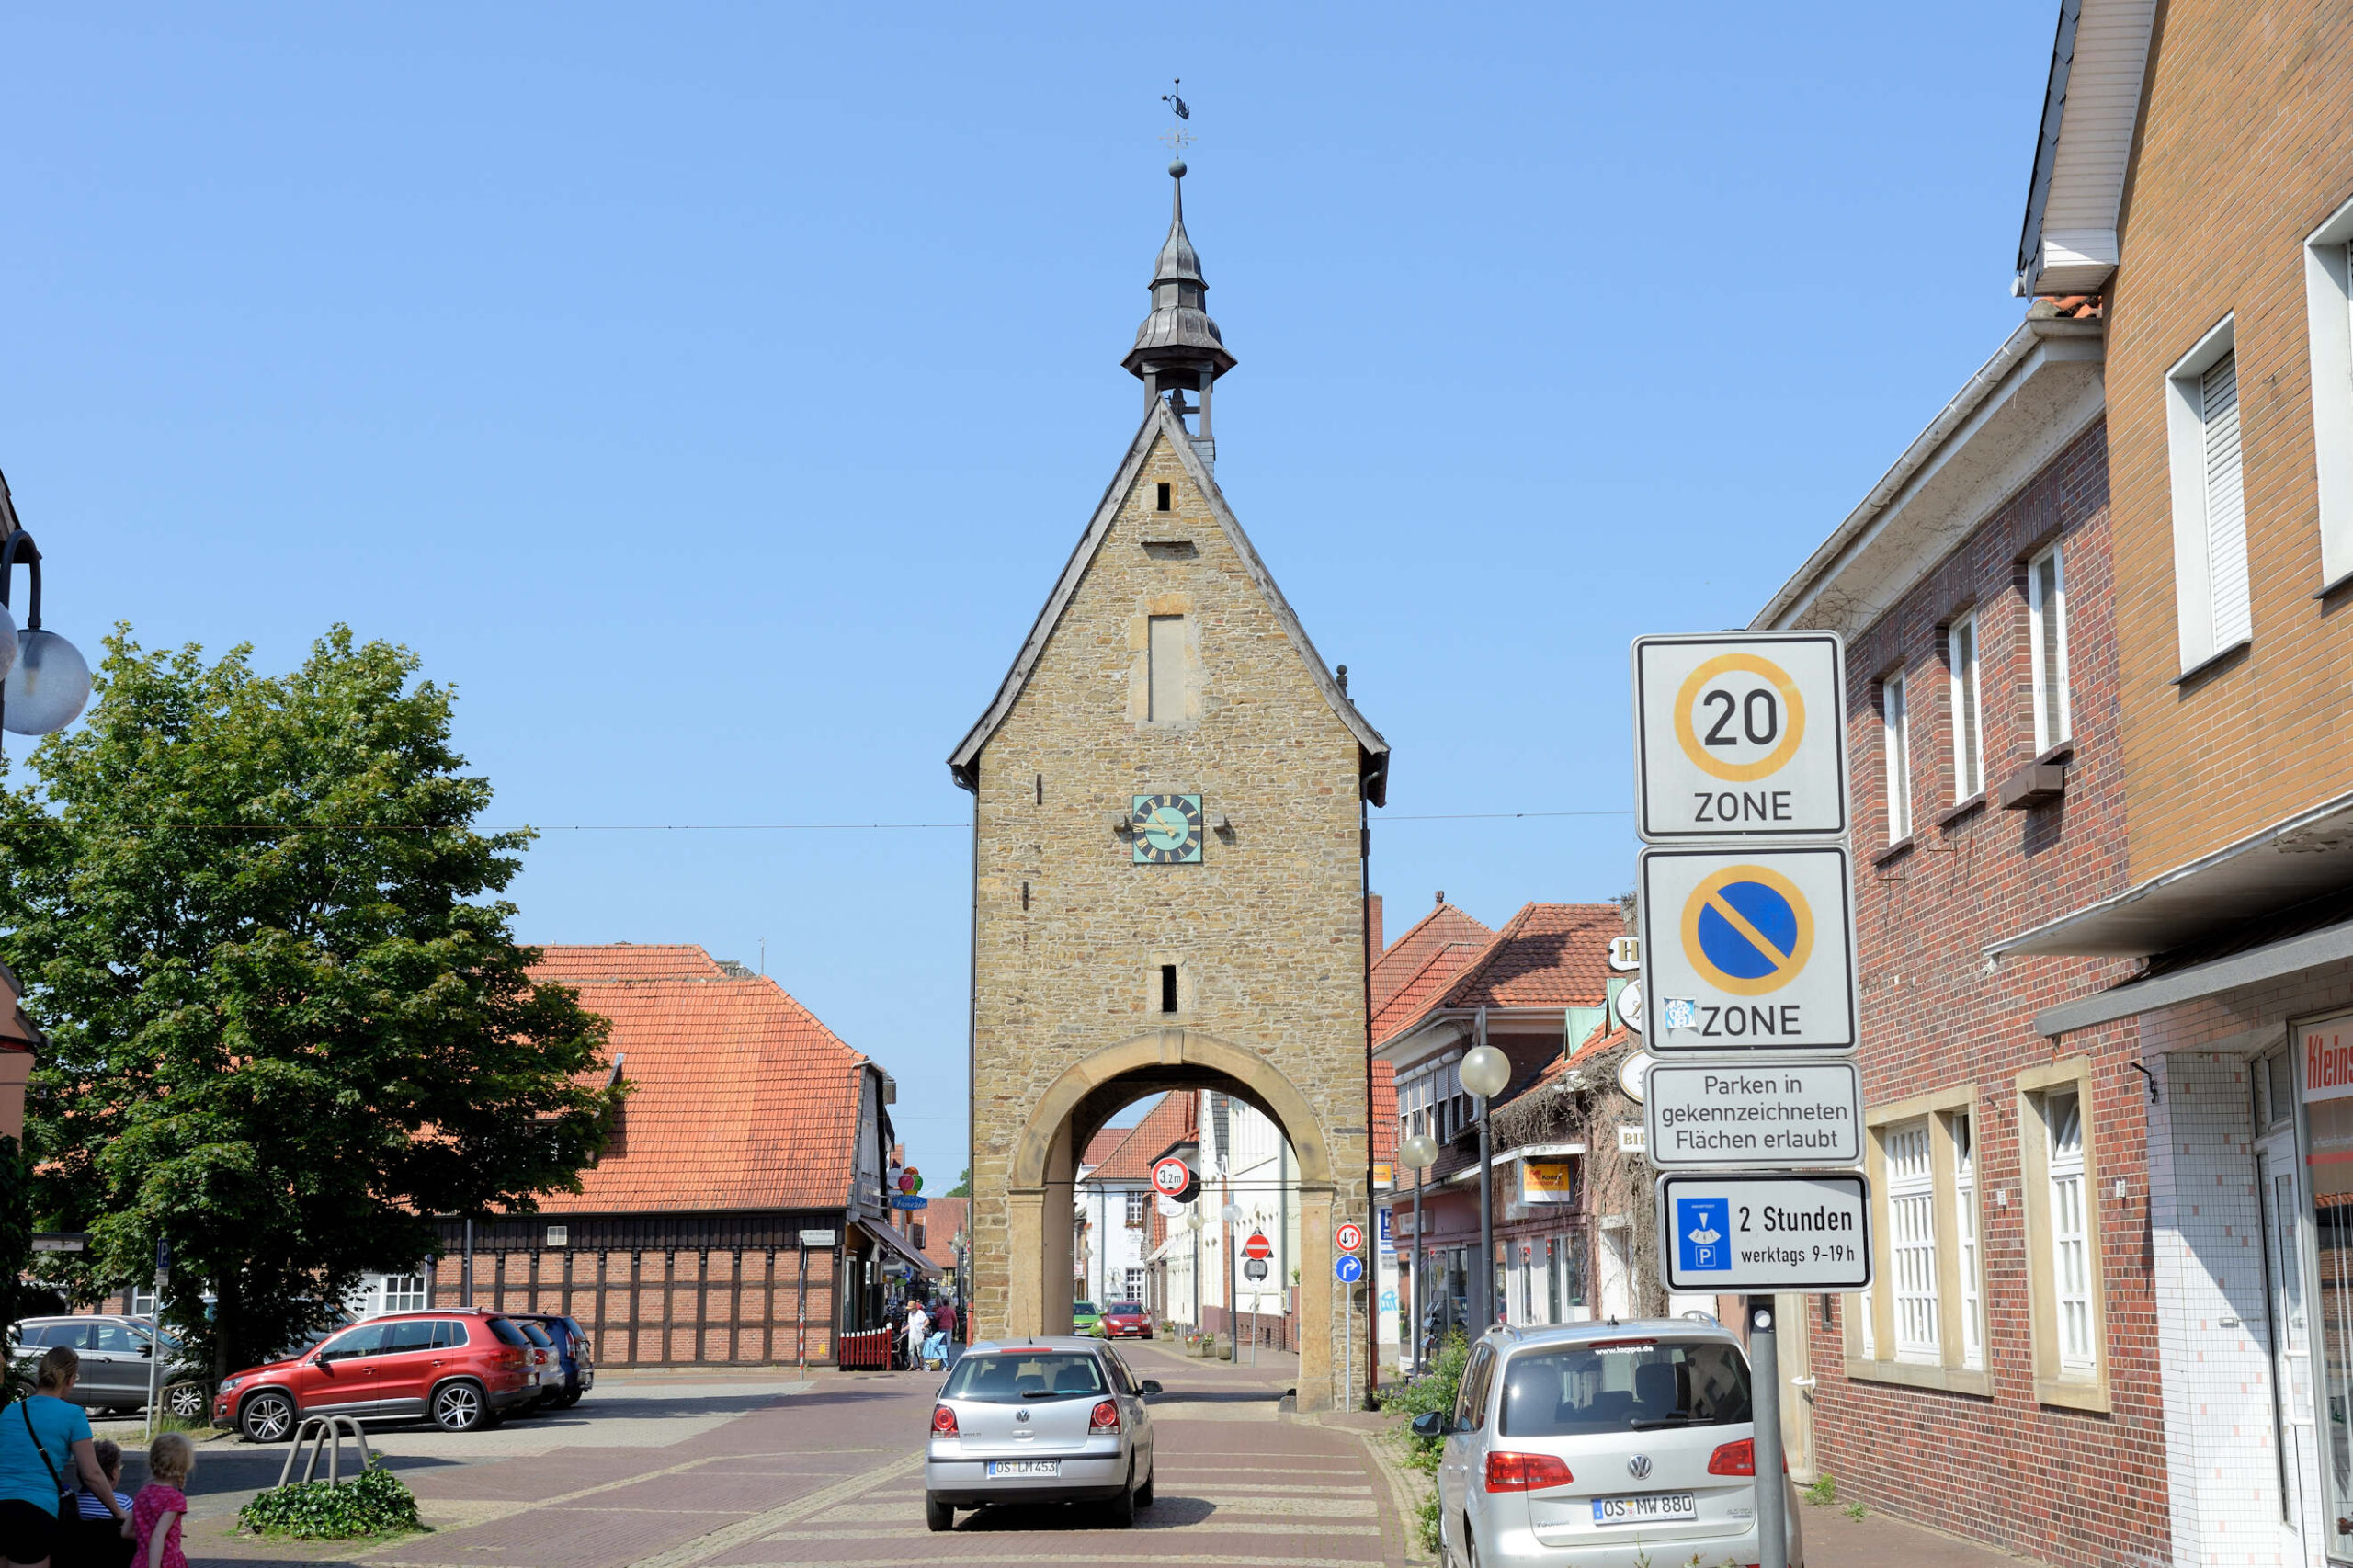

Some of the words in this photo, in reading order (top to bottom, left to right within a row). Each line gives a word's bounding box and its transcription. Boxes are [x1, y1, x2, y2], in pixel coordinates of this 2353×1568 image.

[1703, 689, 1778, 745] 20
[1694, 790, 1792, 823] ZONE
[1701, 1005, 1802, 1037] ZONE
[1704, 1075, 1777, 1095] Parken
[1785, 1074, 1802, 1094] in
[1662, 1102, 1848, 1128] gekennzeichneten
[1676, 1130, 1756, 1150] Flächen
[1764, 1129, 1838, 1148] erlaubt
[1739, 1206, 1751, 1232] 2
[1763, 1205, 1853, 1231] Stunden
[161, 1242, 168, 1264] P
[1700, 1249, 1711, 1264] P
[1741, 1246, 1805, 1267] werktags
[996, 1461, 1011, 1473] OS
[1017, 1461, 1033, 1472] LM
[1035, 1460, 1055, 1472] 453
[1604, 1500, 1625, 1517] OS
[1636, 1497, 1657, 1515] MW
